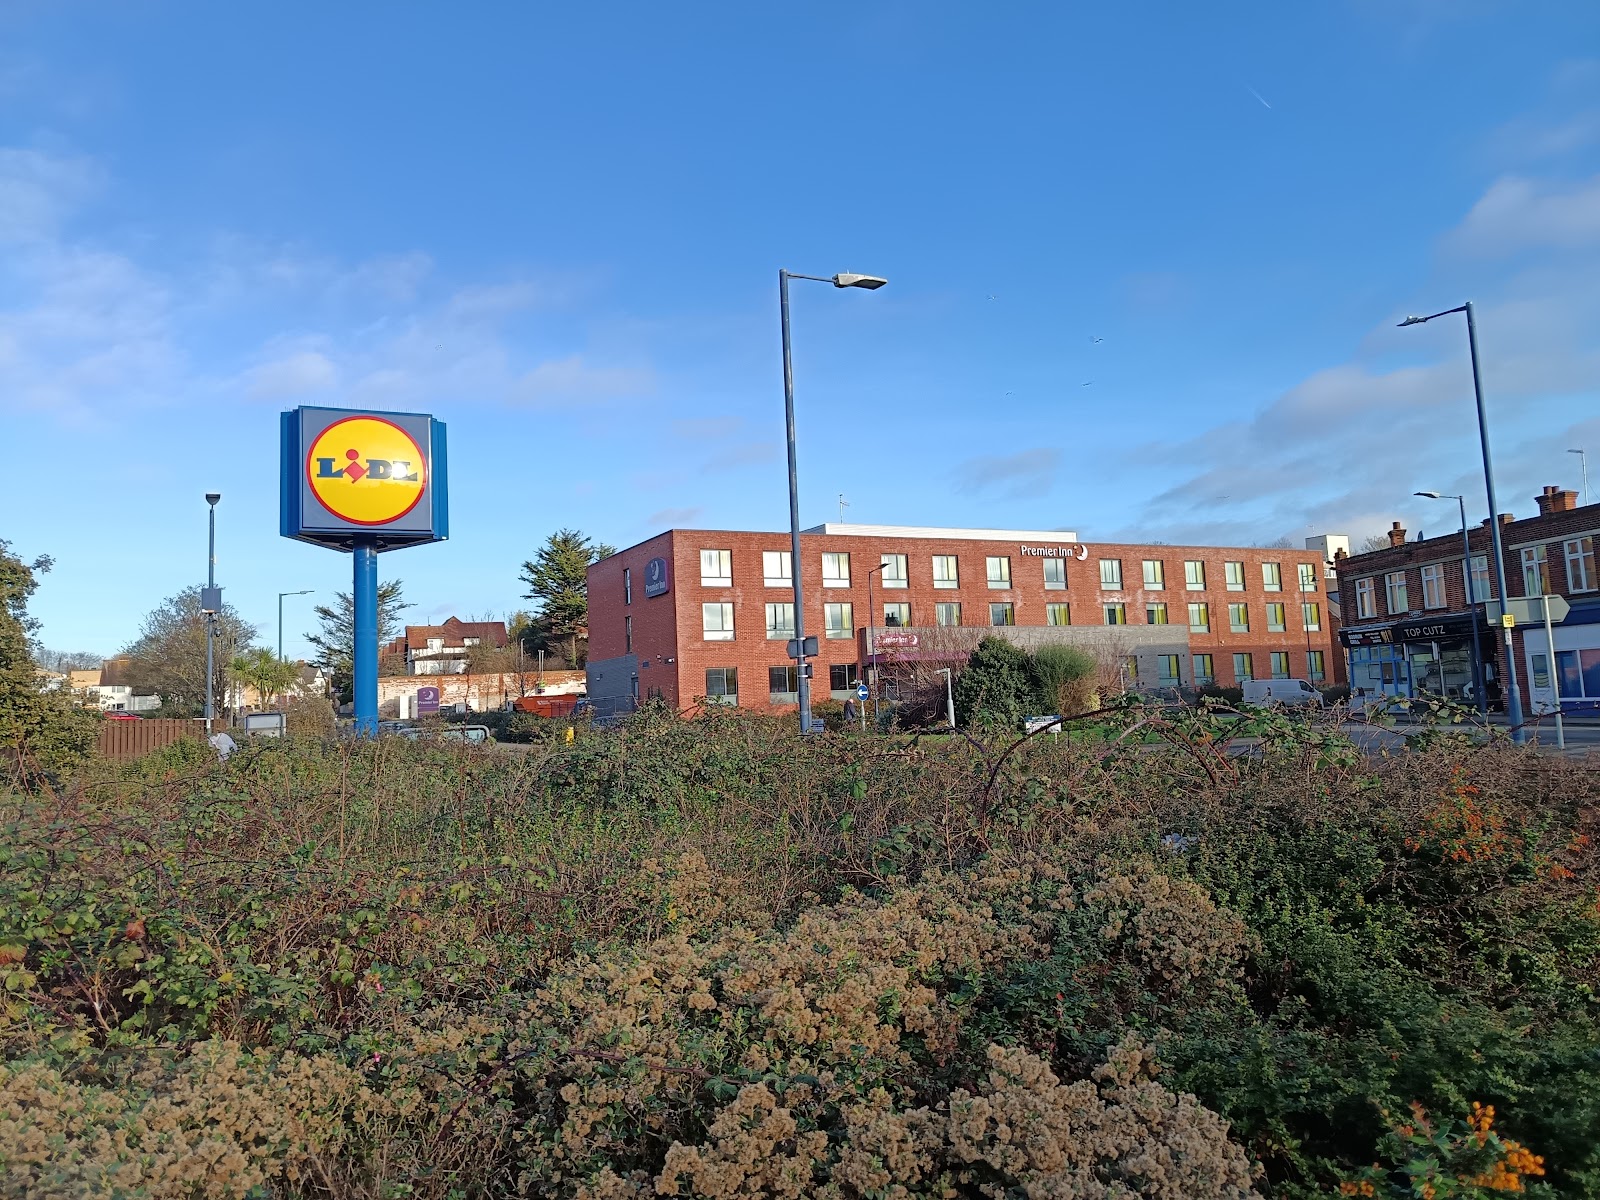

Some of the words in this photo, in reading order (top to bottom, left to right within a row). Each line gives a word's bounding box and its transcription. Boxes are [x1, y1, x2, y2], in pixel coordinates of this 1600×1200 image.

[1021, 545, 1057, 556] Premier
[1059, 545, 1073, 557] Inn
[1404, 628, 1421, 637] TOP
[1423, 625, 1446, 635] CUTZ
